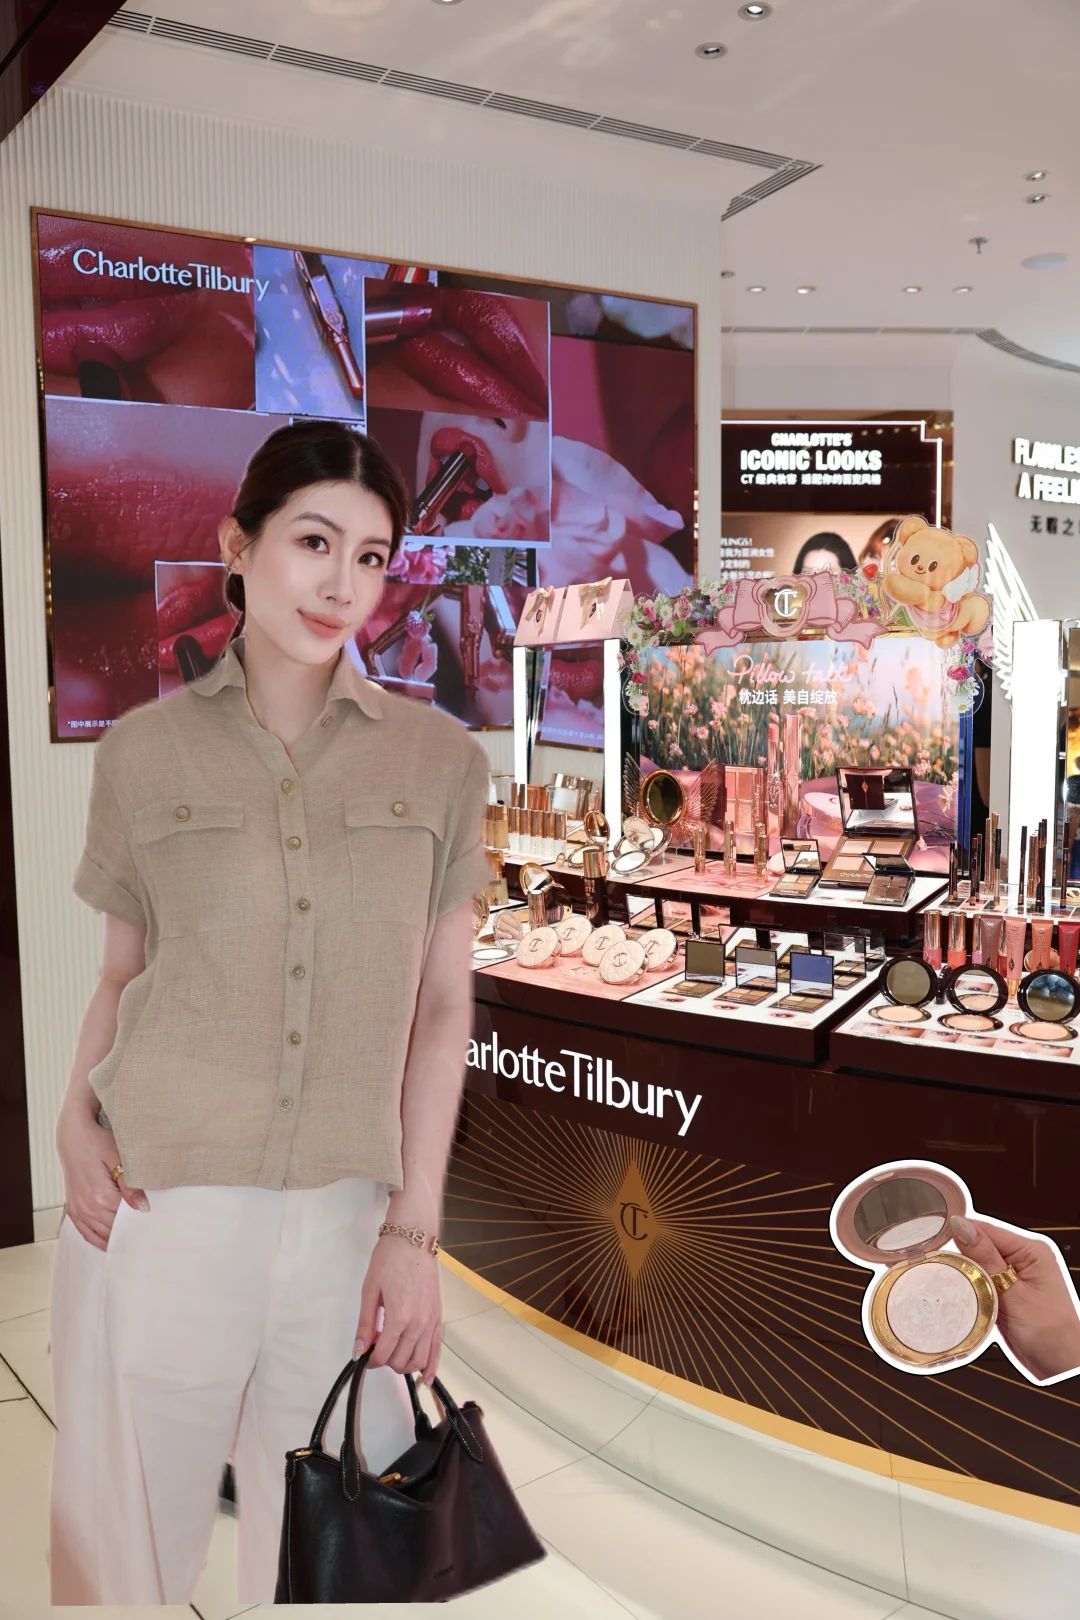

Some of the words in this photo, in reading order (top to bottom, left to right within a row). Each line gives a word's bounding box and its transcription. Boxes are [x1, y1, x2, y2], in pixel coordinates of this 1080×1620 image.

[771, 432, 852, 447] CHARLOTTE'S
[740, 450, 810, 471] ICONIC
[815, 450, 882, 471] LOOKS
[740, 473, 755, 485] CT
[1018, 472, 1031, 499] A
[739, 689, 777, 705] 枕边话
[783, 689, 838, 705] 美自绽放
